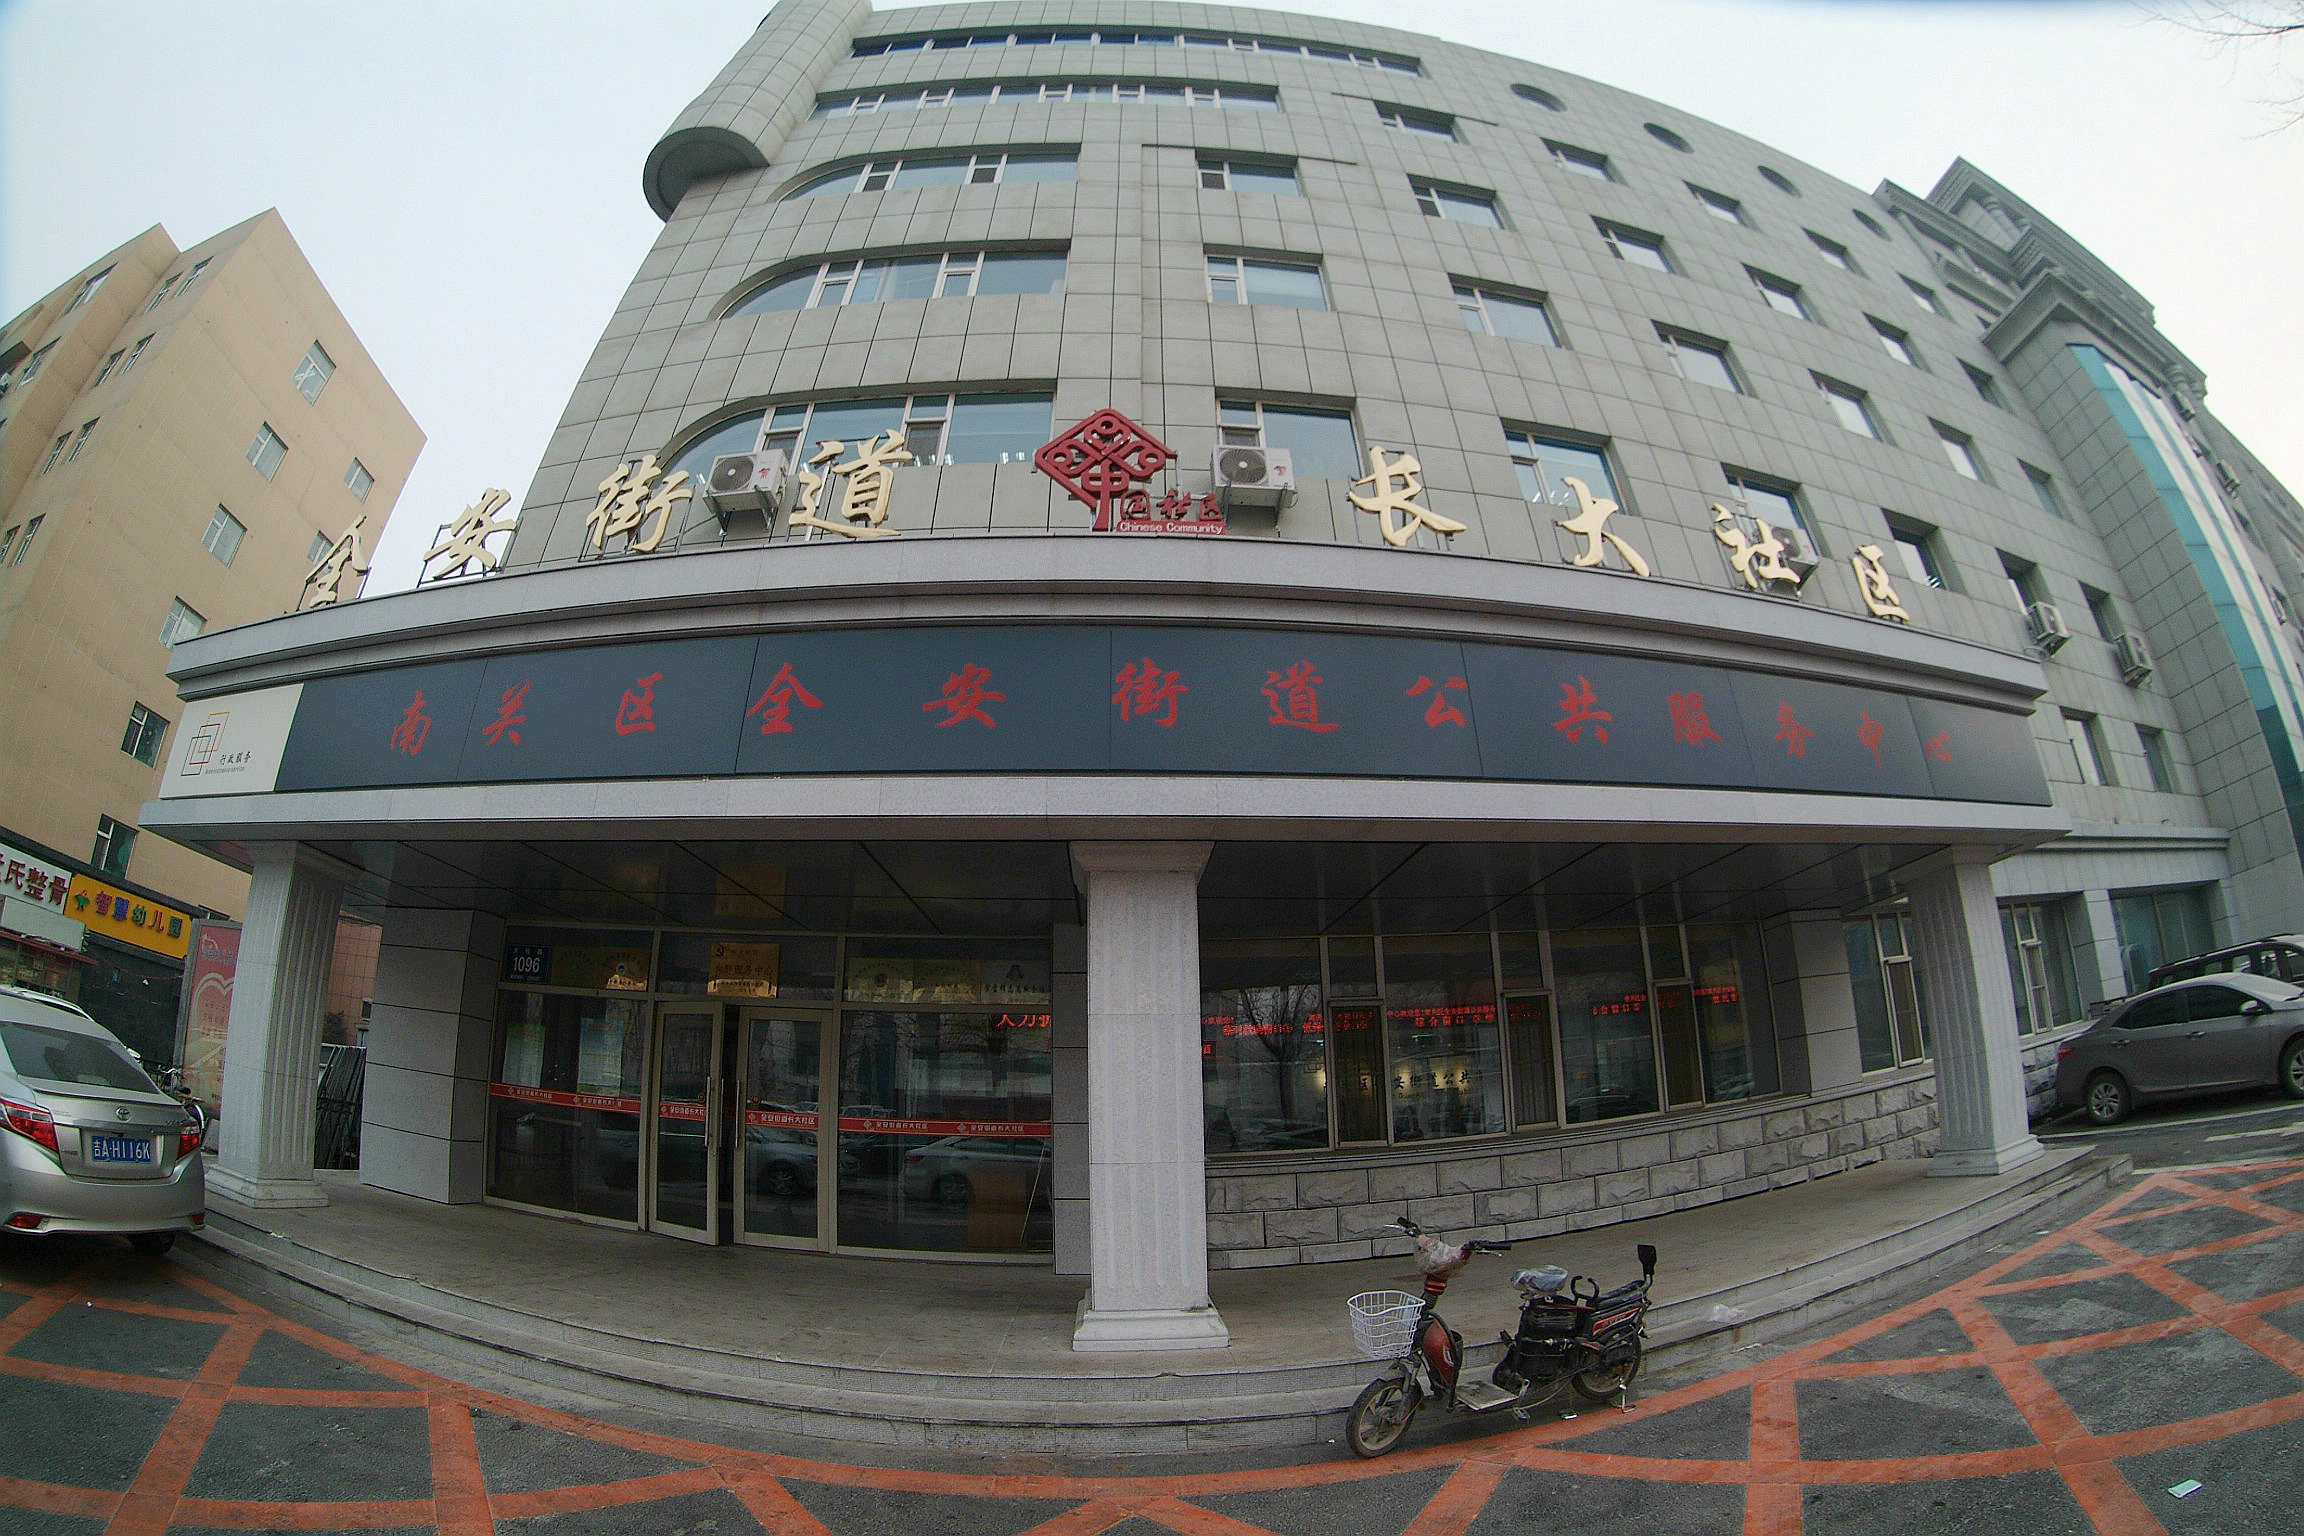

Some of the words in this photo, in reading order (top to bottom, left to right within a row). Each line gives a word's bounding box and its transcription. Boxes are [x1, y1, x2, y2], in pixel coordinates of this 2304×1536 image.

[305, 429, 913, 607] 全安街道
[1348, 446, 1910, 622] 长大社区
[1119, 522, 1163, 532] Chinese
[1166, 523, 1223, 535] Community
[390, 656, 1953, 770] 南关区全安街道公共服务中心
[513, 956, 541, 974] 1096
